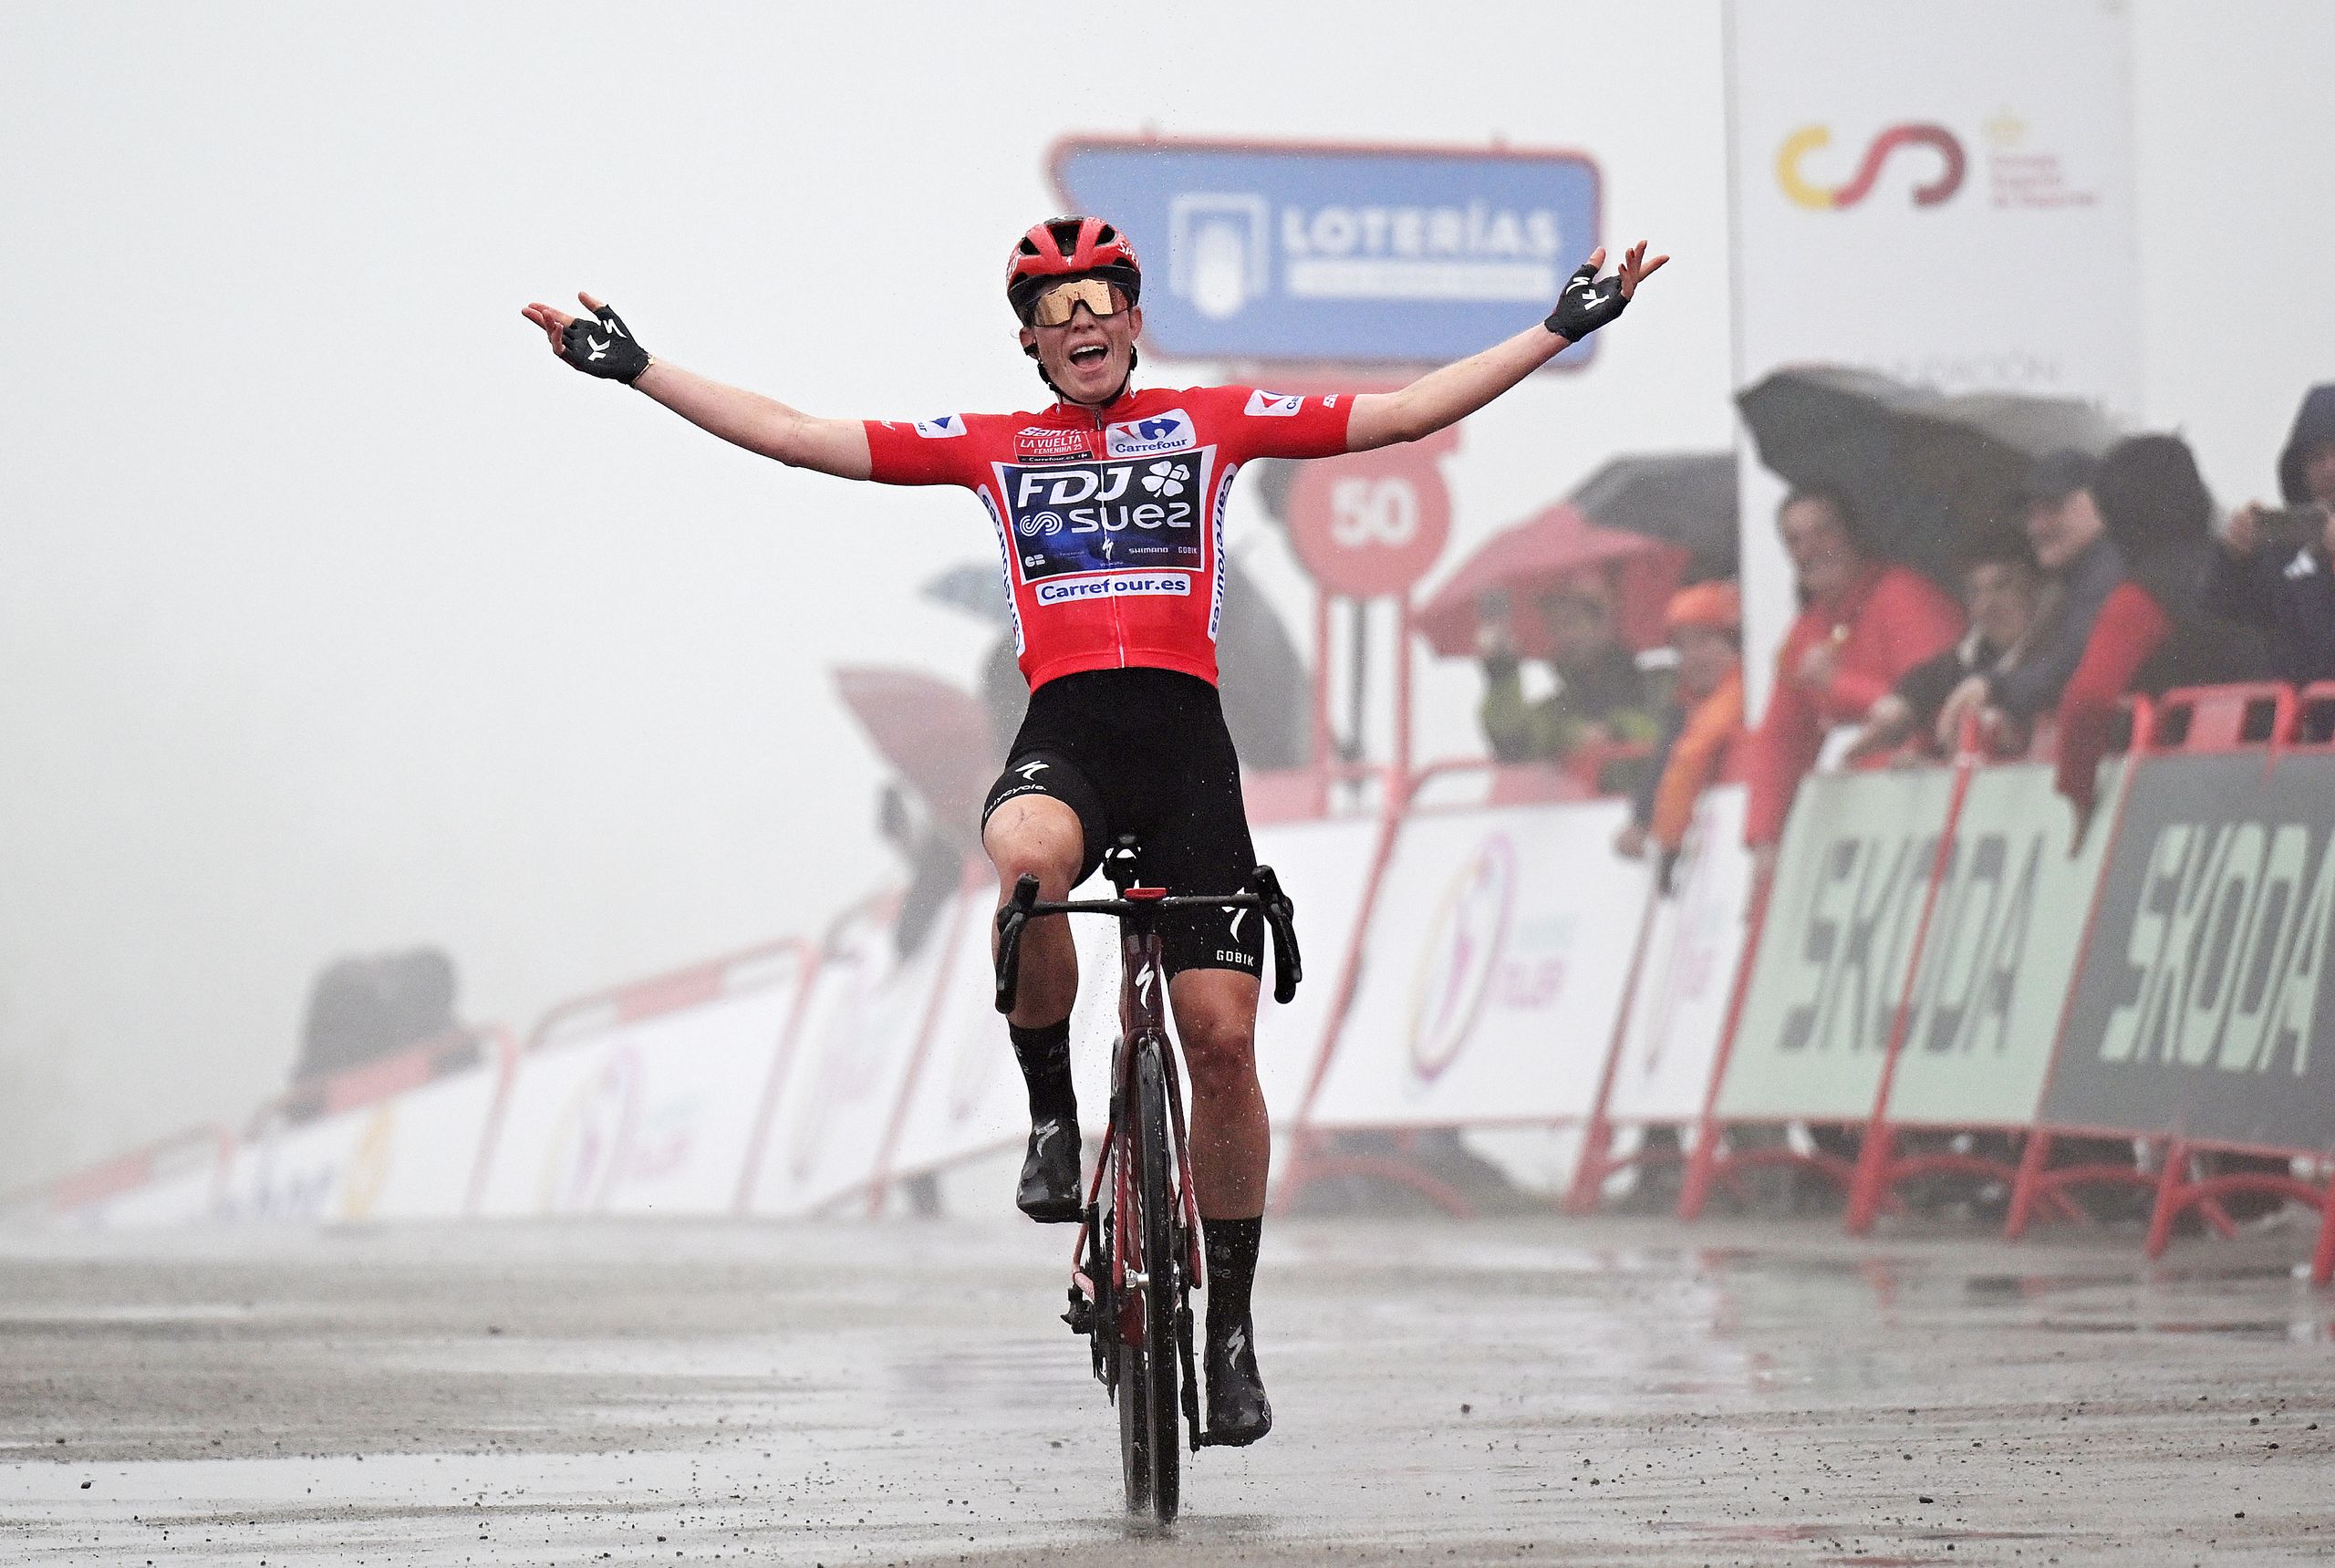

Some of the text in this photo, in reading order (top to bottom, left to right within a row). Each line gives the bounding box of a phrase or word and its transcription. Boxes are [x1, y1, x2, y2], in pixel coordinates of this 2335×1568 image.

[1282, 200, 1558, 255] LOTERÍAS
[1020, 435, 1082, 448] LA VUELTA
[1033, 445, 1072, 454] FEMENINA
[1115, 439, 1188, 453] Carrefour
[1018, 466, 1133, 508] FDJ
[1332, 477, 1417, 545] 50
[1041, 578, 1186, 600] Carrefour.es
[1216, 950, 1254, 967] GOBIK
